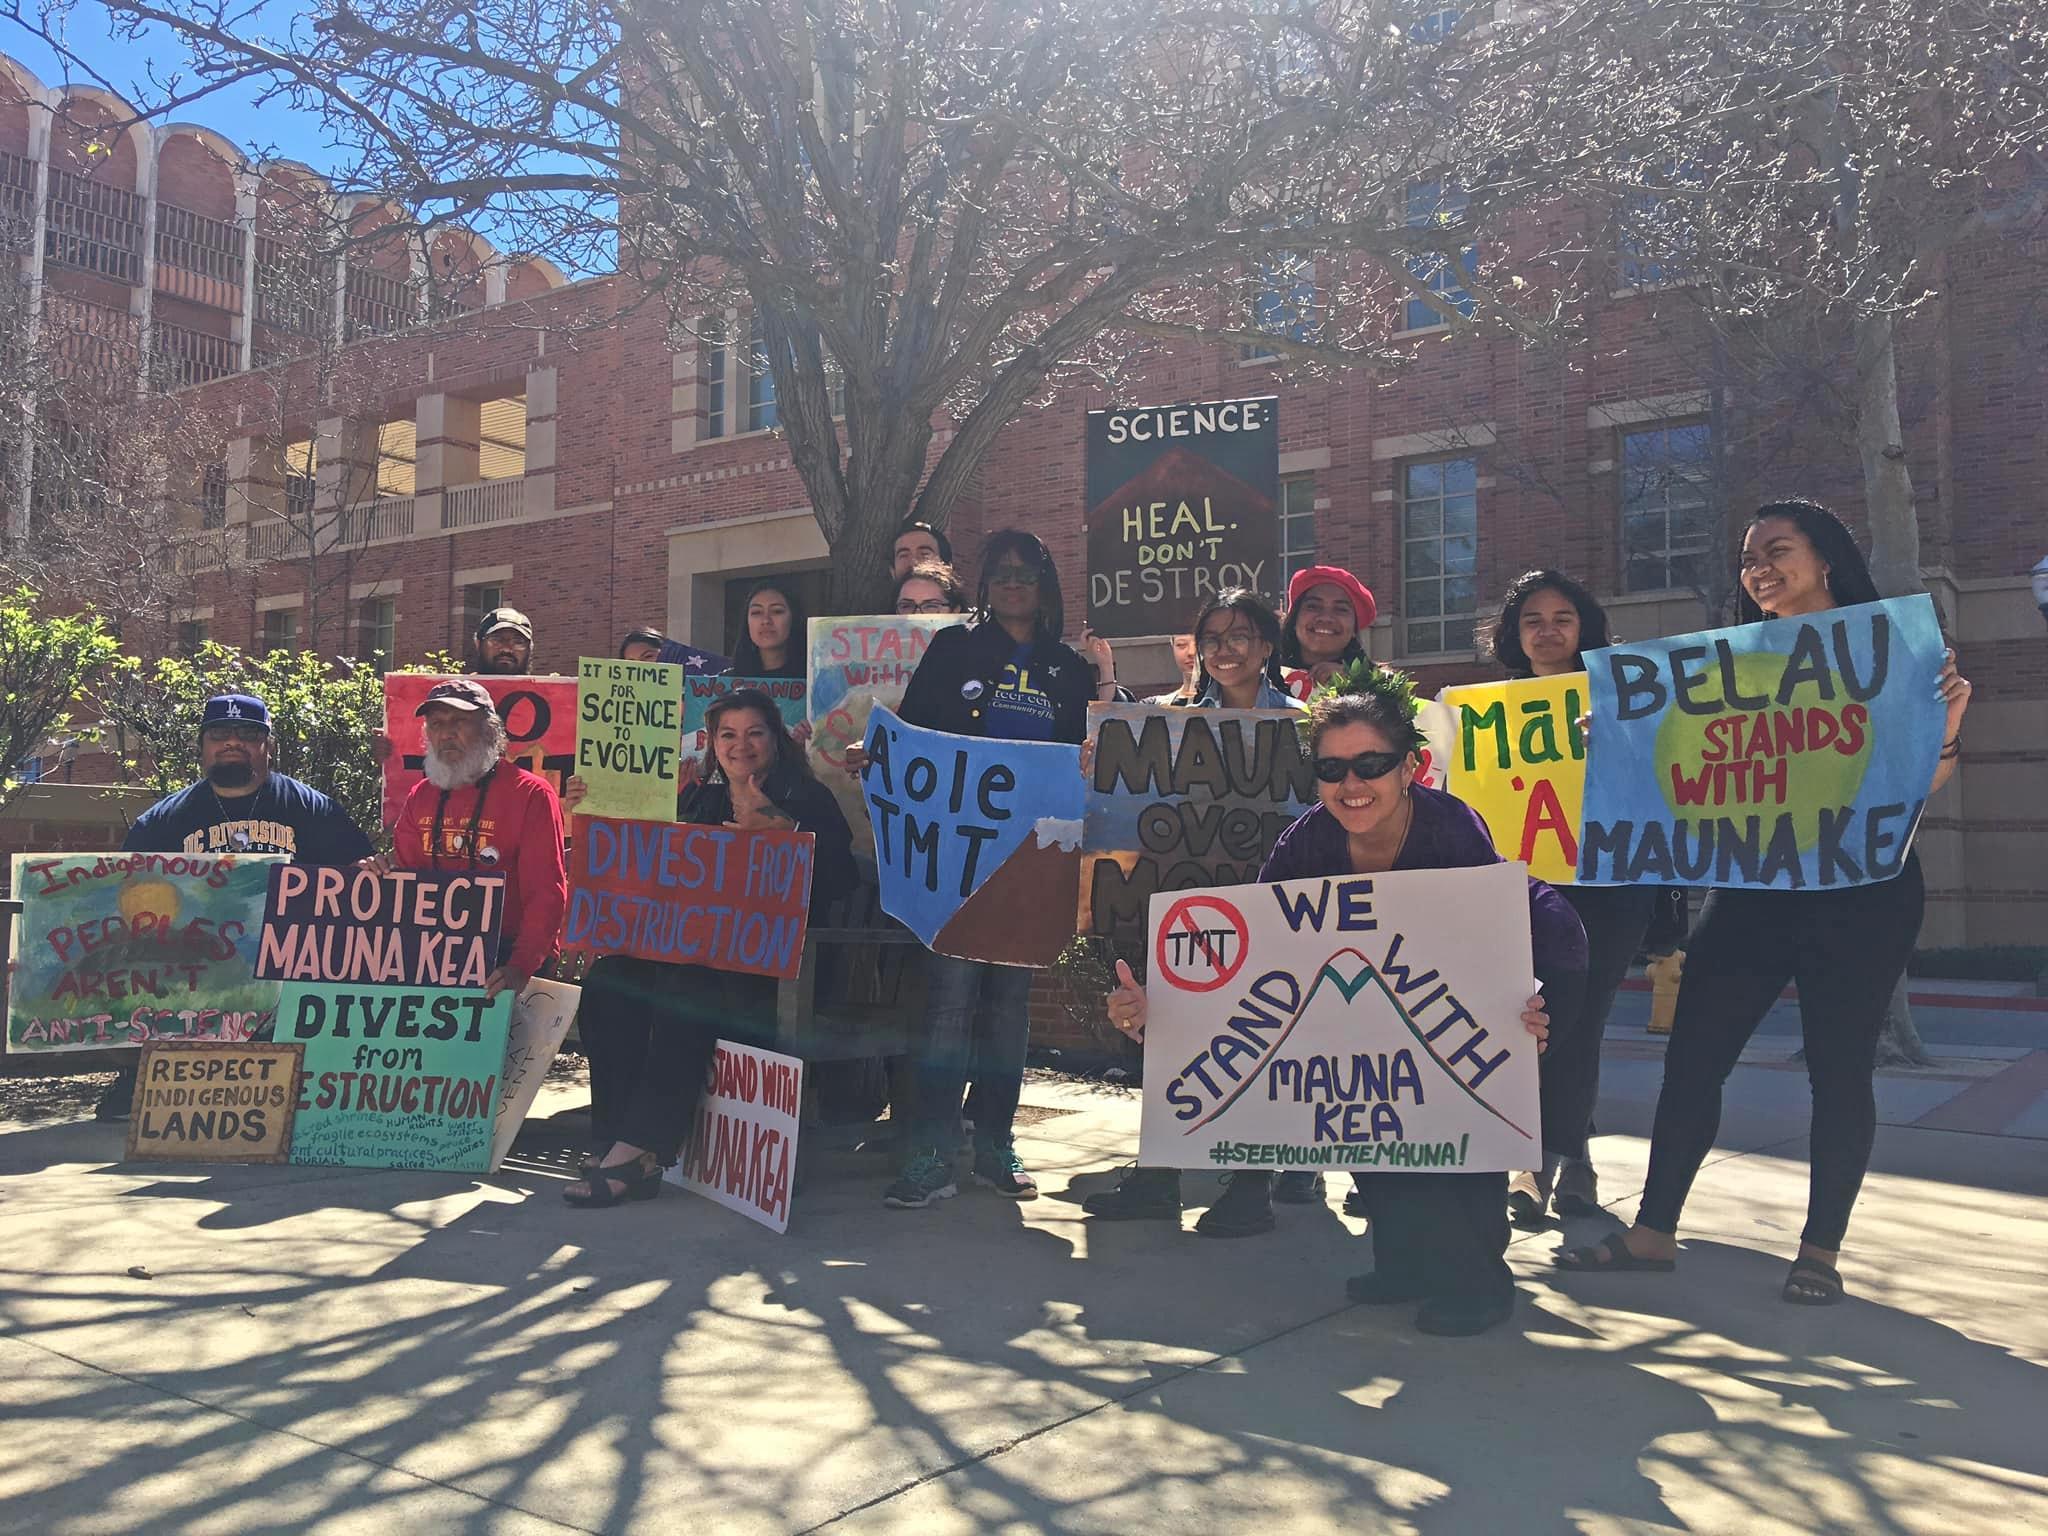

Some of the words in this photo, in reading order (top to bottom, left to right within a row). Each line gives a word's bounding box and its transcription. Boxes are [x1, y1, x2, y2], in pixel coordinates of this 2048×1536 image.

[1107, 403, 1270, 444] SCIENCE:
[1123, 497, 1237, 542] HEAL.
[1138, 537, 1223, 566] DON'T
[1091, 560, 1271, 608] DESTROY.
[831, 627, 936, 661] STAN
[583, 664, 603, 679] IT
[608, 665, 622, 680] IS
[626, 666, 669, 686] TIME
[1609, 614, 1889, 720] BELAU
[226, 699, 242, 718] LA
[582, 693, 677, 730] SCIENCE
[610, 684, 636, 699] FOR
[613, 726, 631, 741] TO
[1459, 688, 1585, 771] Māl
[1701, 703, 1867, 762] STANDS
[580, 738, 674, 780] EVOLVE
[1093, 715, 1317, 806] MAUN
[1671, 759, 1788, 806] WITH
[183, 829, 205, 854] UC
[870, 793, 999, 898] TMT
[1579, 811, 1805, 890] MAUNA
[1818, 800, 1925, 887] KE
[28, 853, 236, 895] Indigenous
[588, 821, 737, 893] DIVEST
[743, 834, 813, 906] FROM
[276, 867, 504, 933] PROTECT
[1272, 879, 1378, 932] WE
[47, 911, 245, 964] PEOPLES
[565, 886, 800, 971] DESTRUCTION
[1166, 928, 1237, 967] TMT
[256, 923, 405, 983] MAUNA
[415, 931, 486, 986] KEA
[51, 963, 208, 1002] AREN'T
[294, 994, 495, 1042] DIVEST
[1381, 933, 1511, 1090] WITH
[352, 1045, 423, 1070] from
[1165, 969, 1301, 1121] STAND
[151, 1058, 277, 1082] RESPECT
[761, 1060, 799, 1118] WITH
[1268, 1048, 1424, 1105] MAUNA
[145, 1085, 285, 1108] INDIGENOUS
[296, 1071, 496, 1119] ESTRUCTION
[140, 1108, 267, 1142] LANDS
[312, 1126, 353, 1144] fragile
[357, 1128, 439, 1147] ecosystems
[386, 1114, 426, 1128] HUMAN
[408, 1117, 444, 1130] RIGHTS
[1314, 1102, 1403, 1143] KEA
[316, 1142, 376, 1157] cultural
[746, 1122, 790, 1222] KEA
